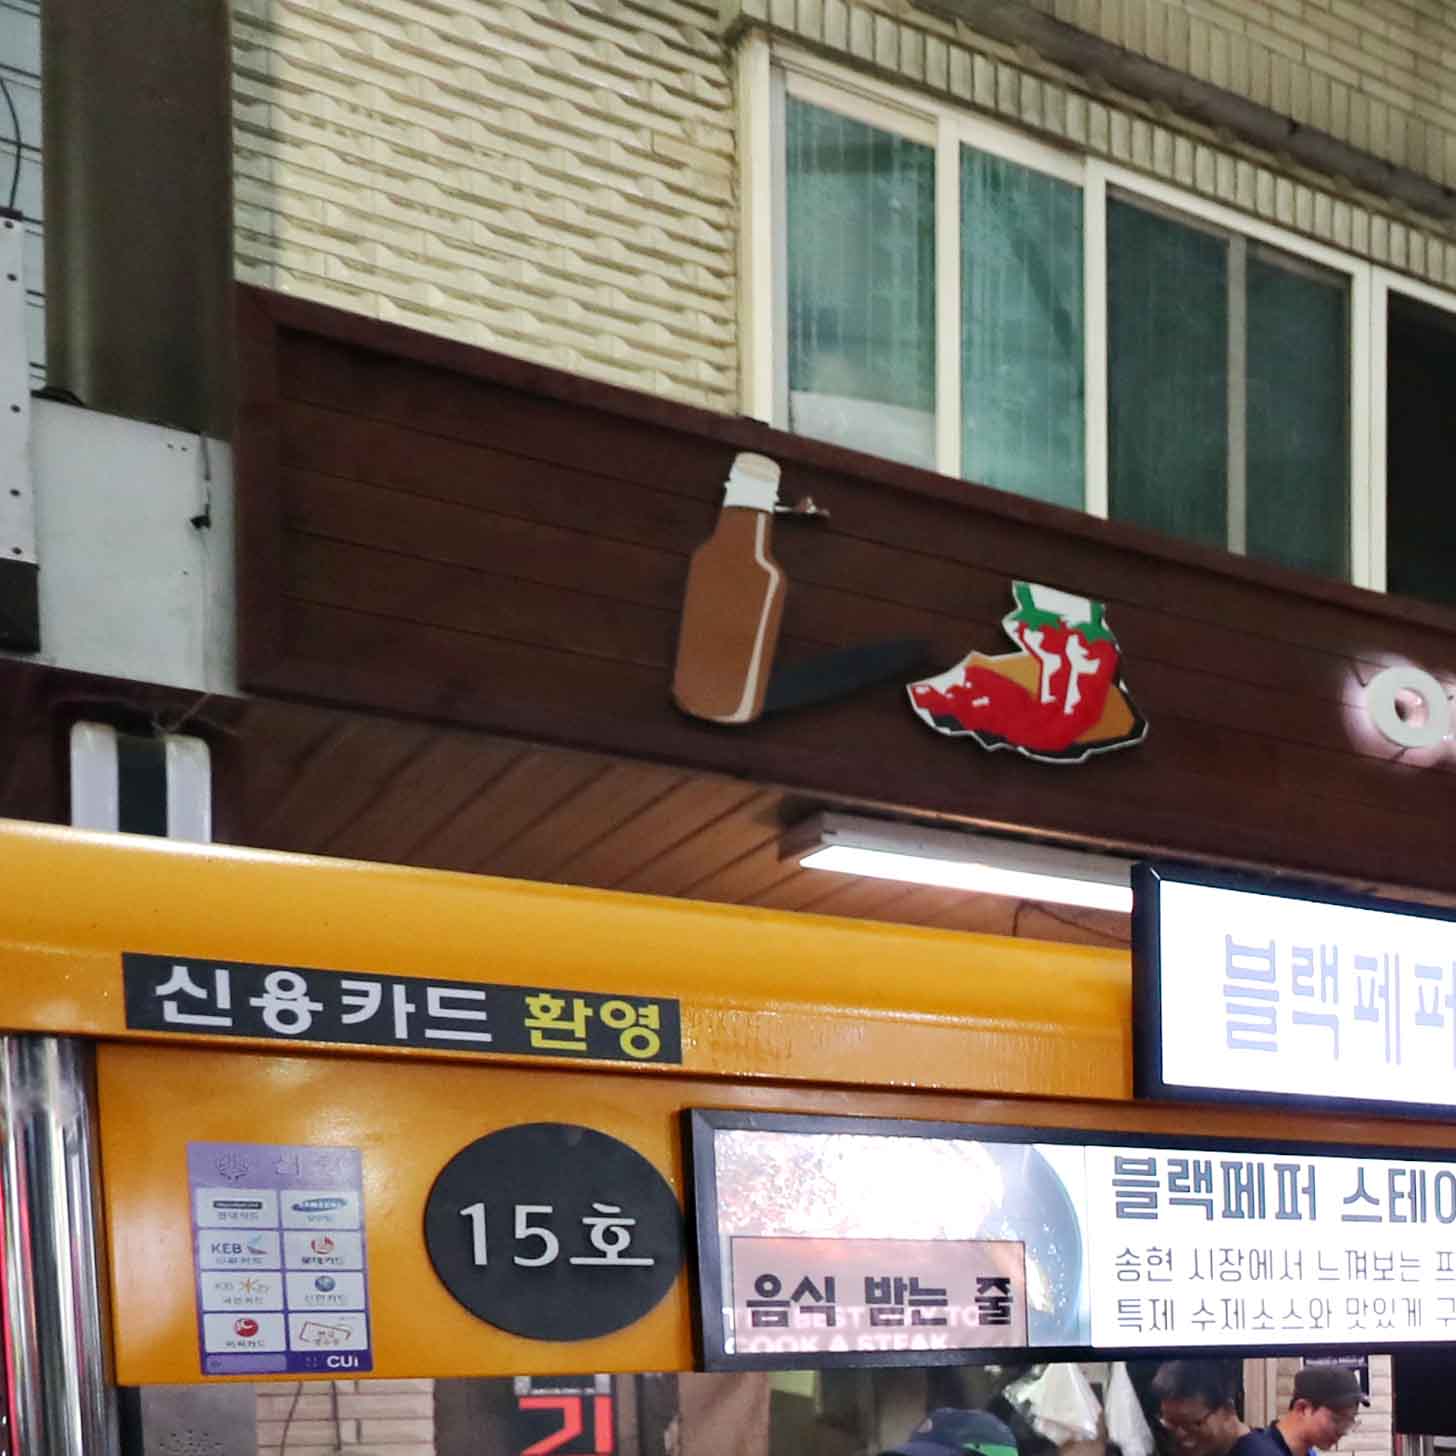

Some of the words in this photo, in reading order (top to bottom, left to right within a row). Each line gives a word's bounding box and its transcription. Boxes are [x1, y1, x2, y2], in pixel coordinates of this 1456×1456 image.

[153, 962, 493, 1043] 신용카드
[523, 992, 662, 1061] 환영
[1112, 1155, 1317, 1222] 블랙페퍼
[457, 1201, 655, 1268] 15호
[1115, 1245, 1173, 1282] 송현
[1189, 1247, 1303, 1282] 시장에서
[1317, 1248, 1421, 1282] 느껴보는
[745, 1273, 837, 1328] 음식
[863, 1274, 948, 1328] 받는
[973, 1276, 1014, 1327] 줄
[1117, 1297, 1175, 1333] 특제
[1191, 1297, 1332, 1332] 수제소스와
[1345, 1296, 1422, 1331] 맛있게
